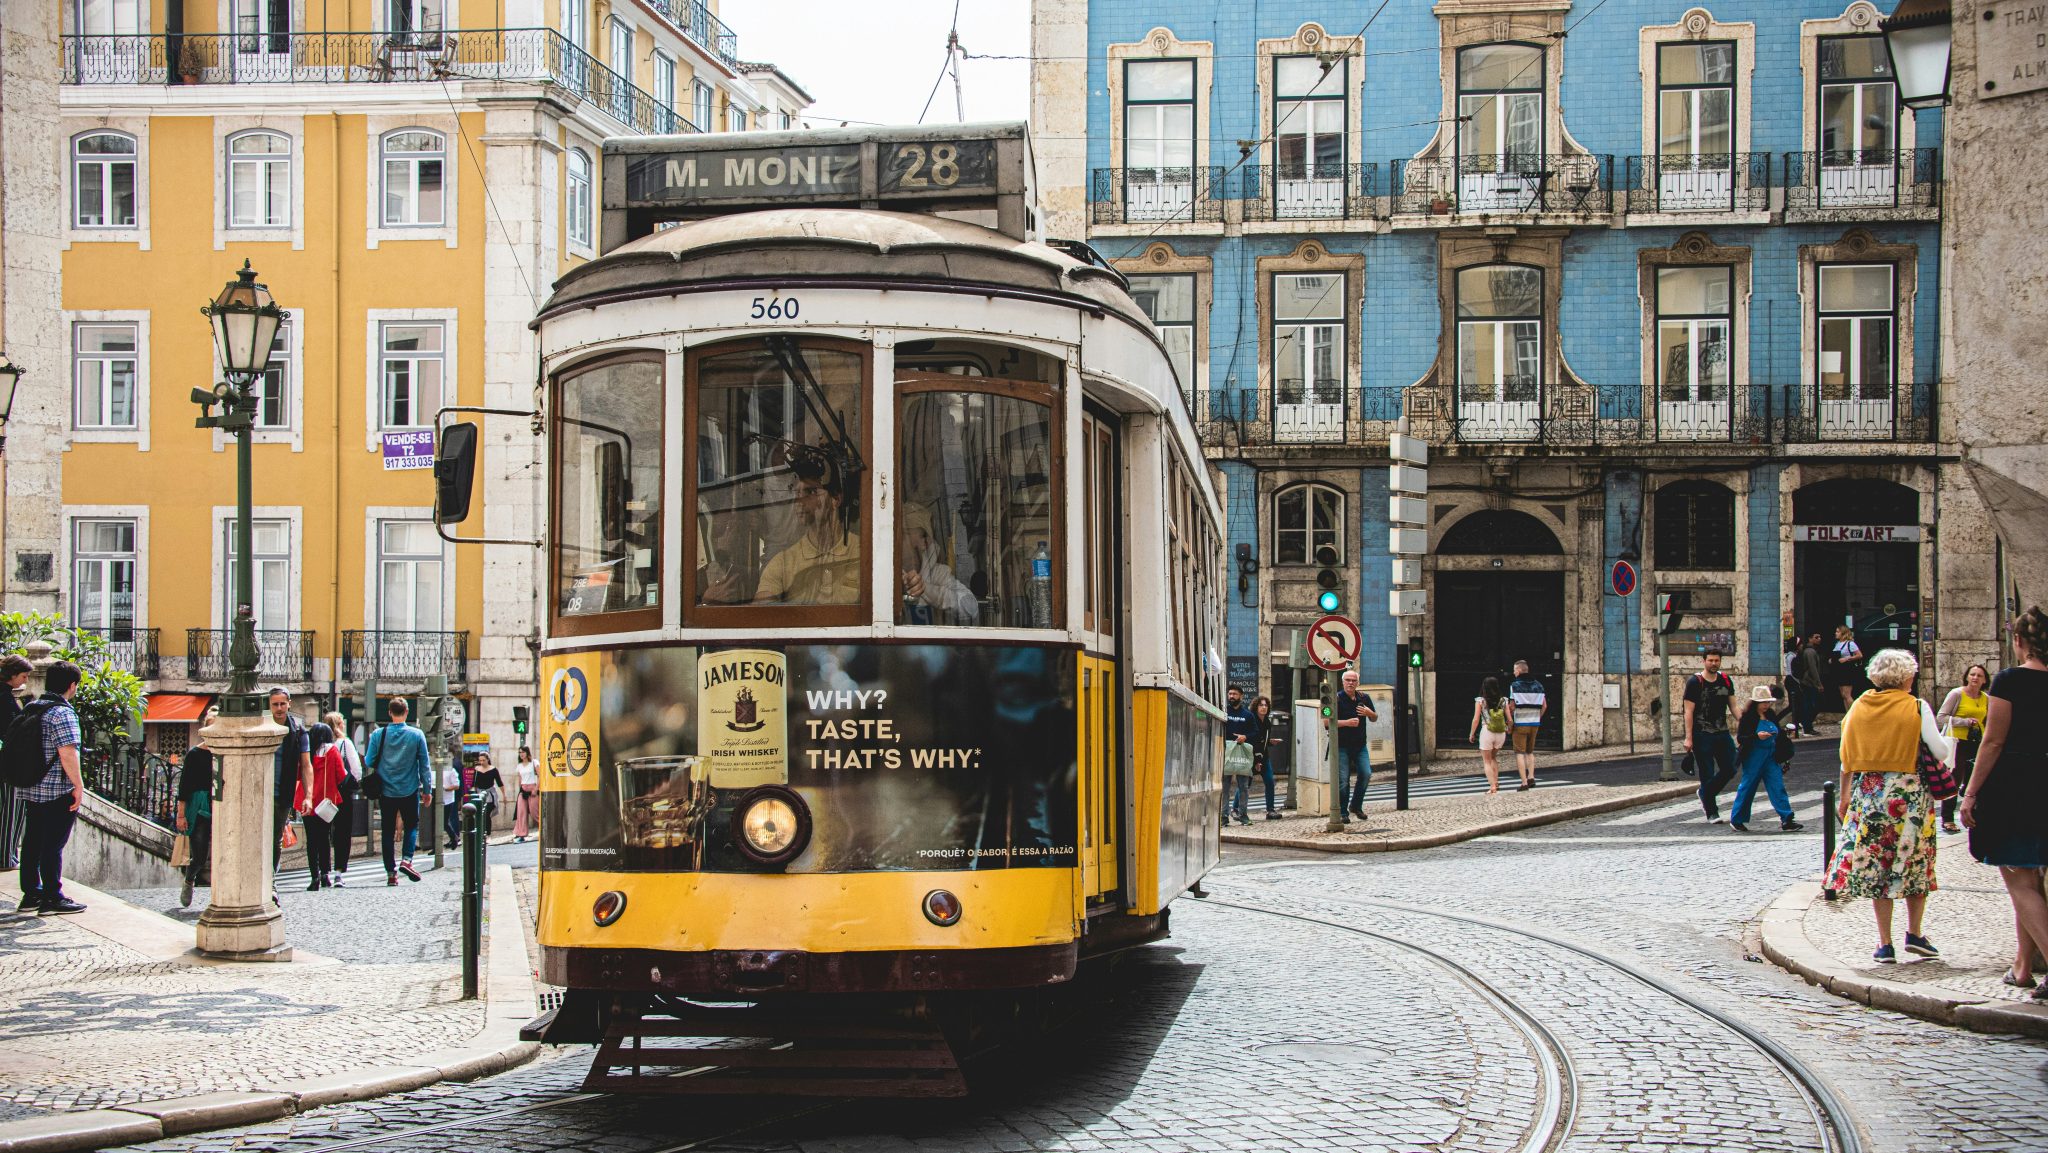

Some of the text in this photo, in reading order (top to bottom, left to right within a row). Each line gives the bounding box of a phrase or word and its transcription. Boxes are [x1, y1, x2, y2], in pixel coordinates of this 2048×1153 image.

[665, 155, 859, 187] M. MONIZ
[899, 143, 960, 187] 28
[751, 297, 800, 320] 560
[385, 432, 432, 445] VENDE-SE
[402, 445, 415, 456] T2
[385, 456, 433, 469] 917 333 035
[1807, 526, 1895, 541] FOLK ART
[573, 578, 588, 588] 28E
[567, 597, 583, 612] 08
[704, 661, 785, 690] JAMESON
[806, 689, 888, 710] WHY?
[806, 719, 901, 743] TASTE,
[711, 748, 779, 757] IRISH WHISKEY
[806, 748, 902, 770] THAT'S
[967, 849, 976, 857] O
[1011, 846, 1018, 856] É
[1049, 845, 1074, 855] RAZÃO
